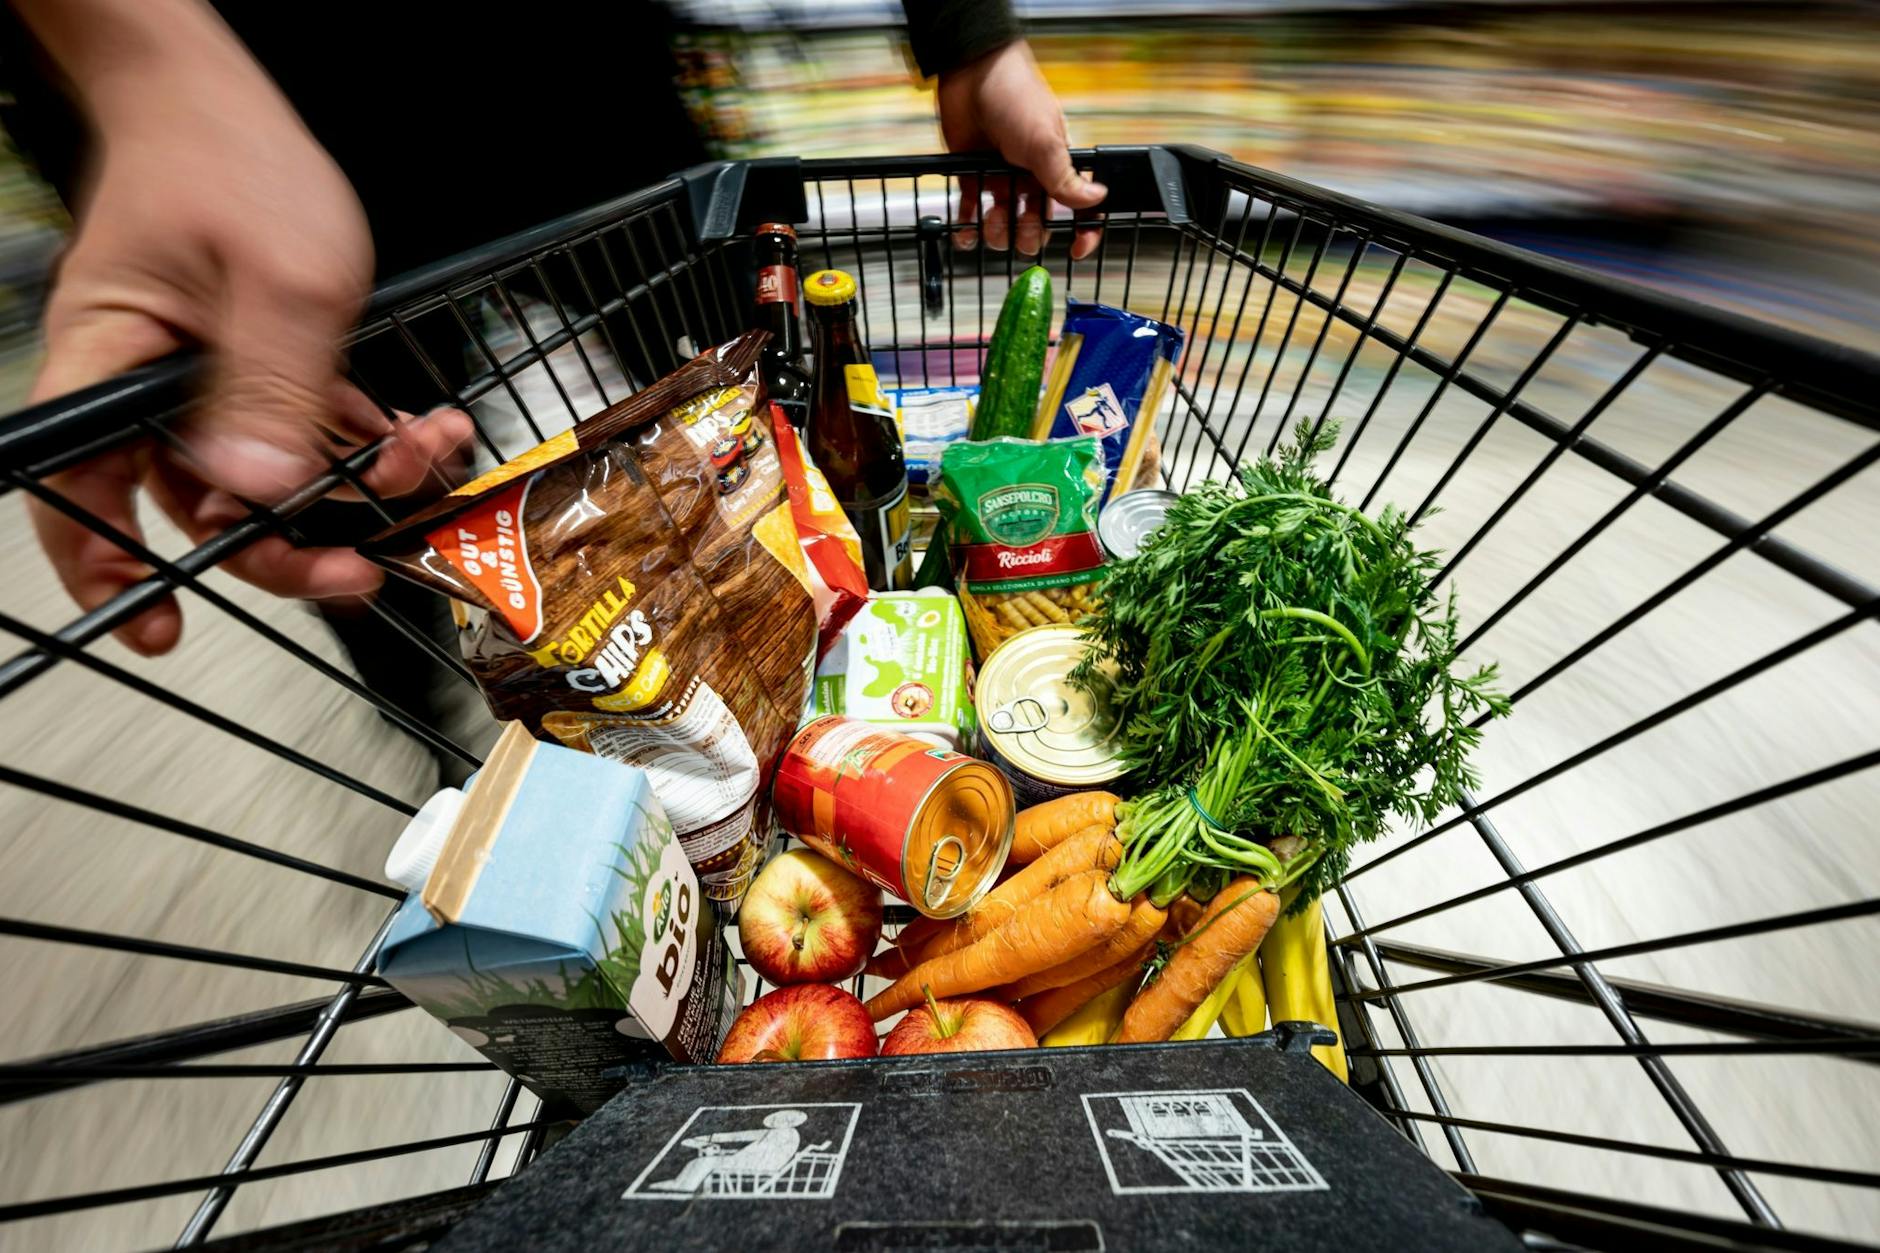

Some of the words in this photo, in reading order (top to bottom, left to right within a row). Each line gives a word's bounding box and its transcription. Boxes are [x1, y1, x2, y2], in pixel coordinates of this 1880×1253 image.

[984, 491, 1053, 513] SANSEPOLCRO
[458, 528, 482, 576] GUT
[480, 551, 498, 568] &
[997, 548, 1053, 568] Riccioli
[1046, 577, 1071, 585] GRANO
[526, 576, 636, 668] TORTILLA
[565, 609, 652, 692] CHIPS
[656, 887, 671, 936] Arla
[655, 883, 690, 1000] bio
